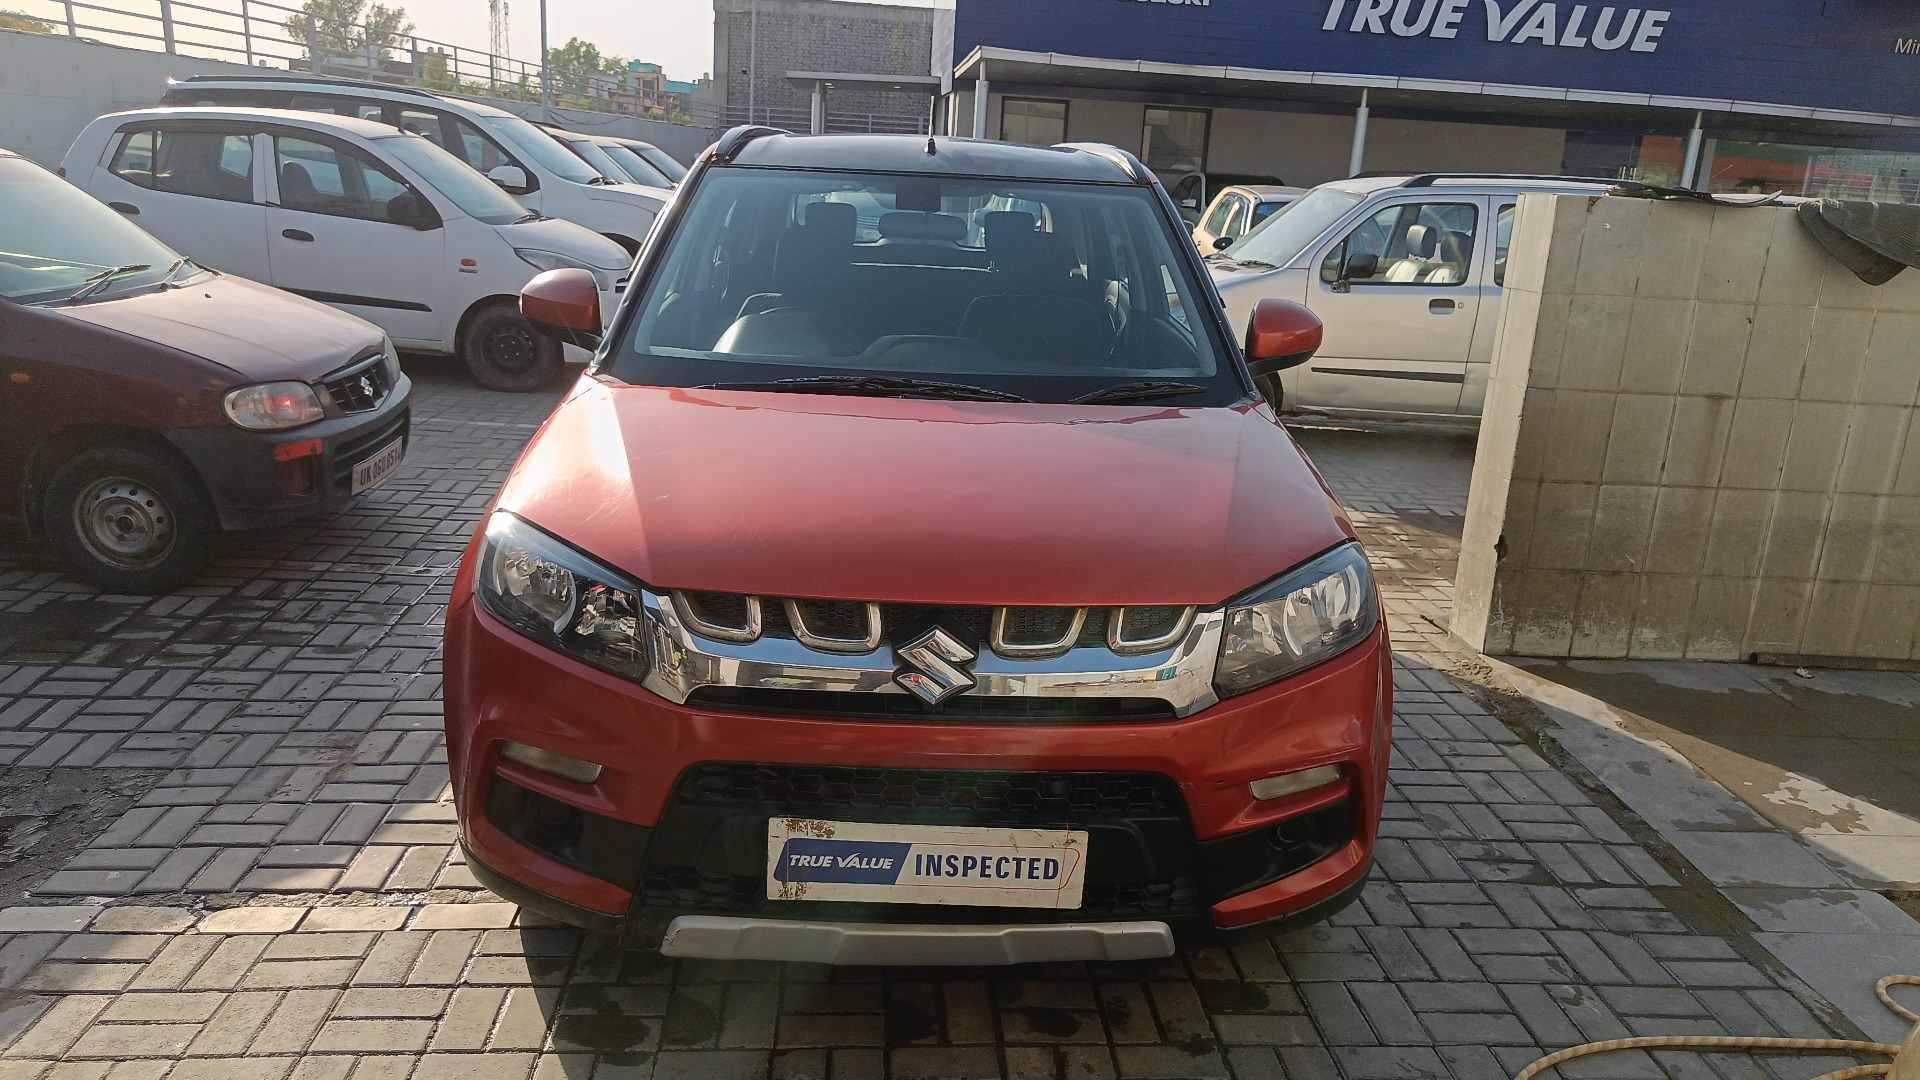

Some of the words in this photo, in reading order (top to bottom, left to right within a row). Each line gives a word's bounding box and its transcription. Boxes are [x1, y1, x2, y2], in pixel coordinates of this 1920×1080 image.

[1322, 0, 1469, 39] TRUE
[1484, 0, 1671, 52] VALUE
[789, 854, 834, 868] TRUE
[836, 852, 894, 870] VALUE
[915, 853, 1060, 880] INSPECTED
